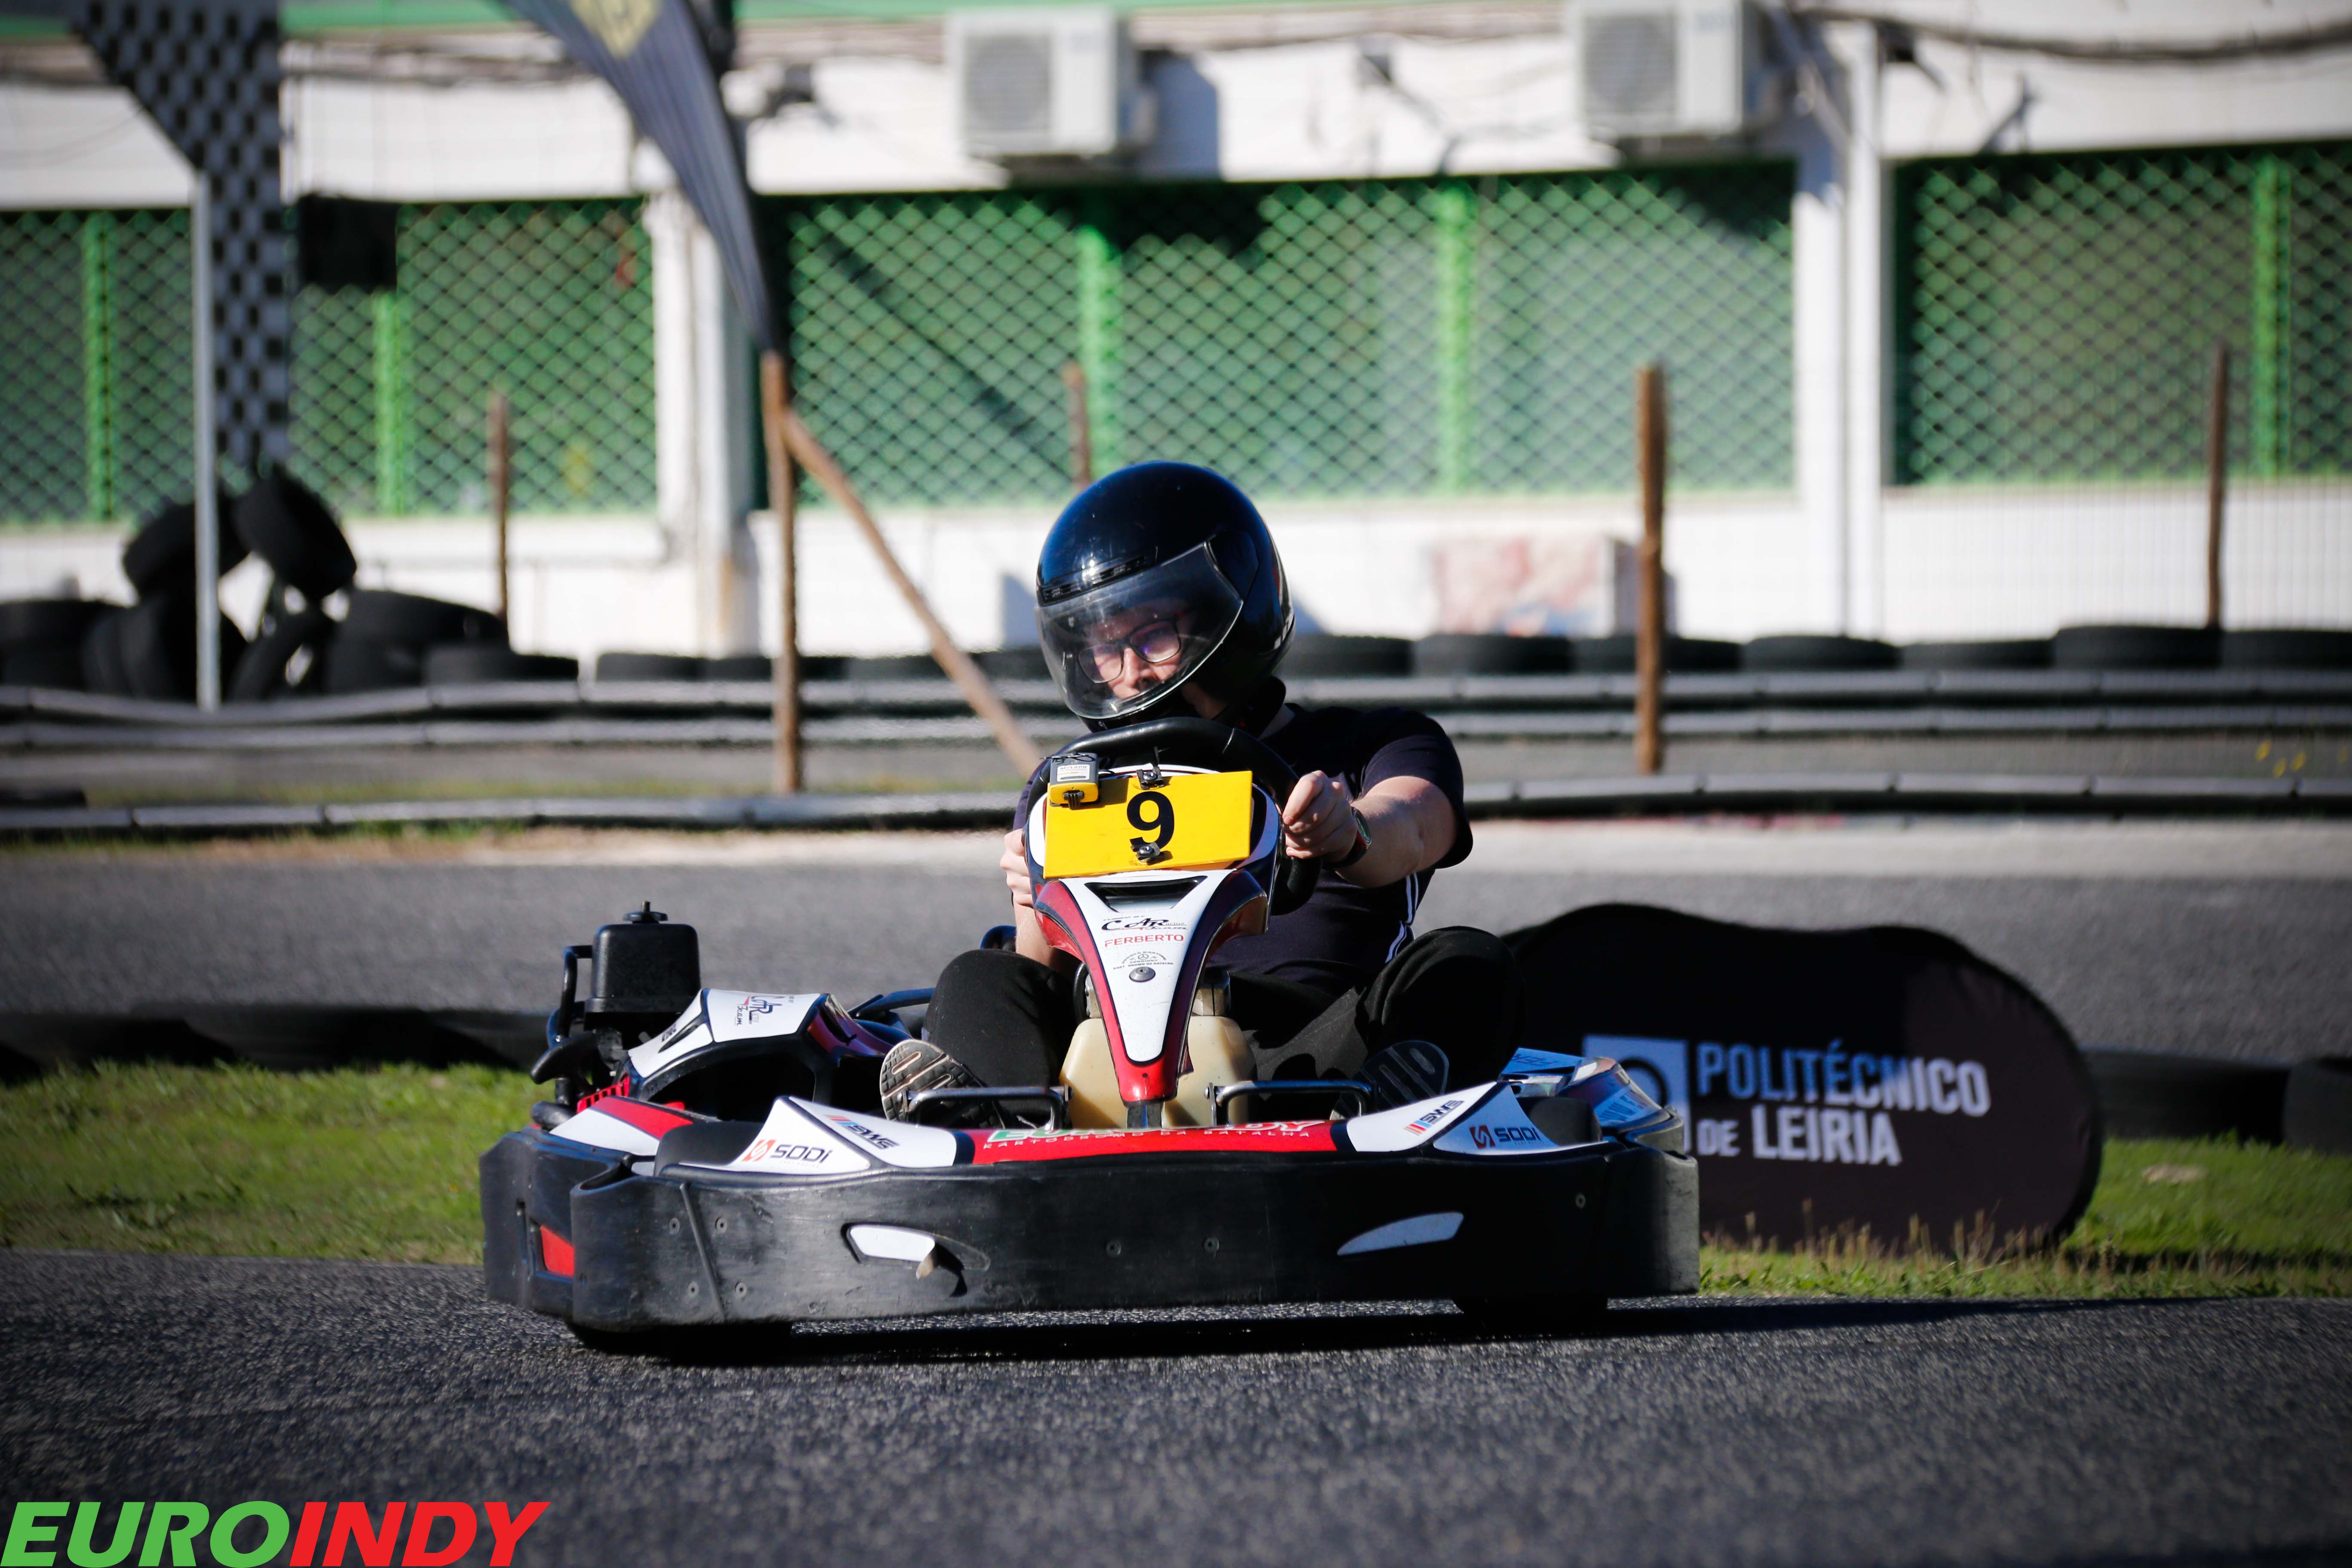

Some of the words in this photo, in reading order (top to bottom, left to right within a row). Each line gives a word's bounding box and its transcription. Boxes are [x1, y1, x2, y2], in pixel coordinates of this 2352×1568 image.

[1127, 791, 1175, 849] 9
[1105, 934, 1184, 947] FERBERTO
[1695, 1038, 1992, 1118] POLITÉCNICO
[1494, 1127, 1542, 1142] SODI
[1696, 1118, 1741, 1158] DE
[1751, 1102, 1903, 1167] LEIRIA
